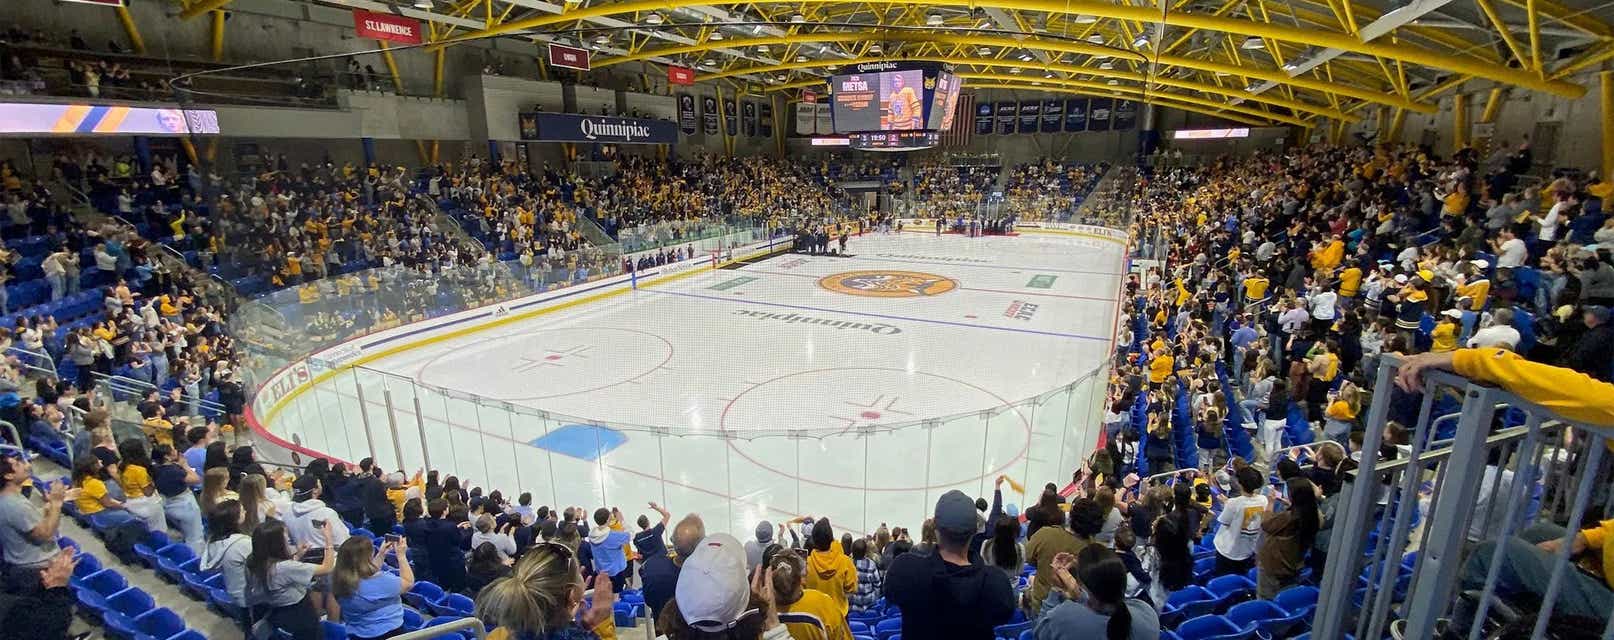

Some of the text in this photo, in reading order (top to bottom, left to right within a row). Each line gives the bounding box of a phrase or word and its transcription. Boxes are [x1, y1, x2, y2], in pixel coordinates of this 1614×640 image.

[377, 22, 414, 37] LAWRENCE
[857, 61, 898, 73] Quinnipiac
[580, 118, 651, 141] Quinnipiac
[731, 309, 903, 336] Quinnipiac
[270, 365, 309, 402] ELI'S
